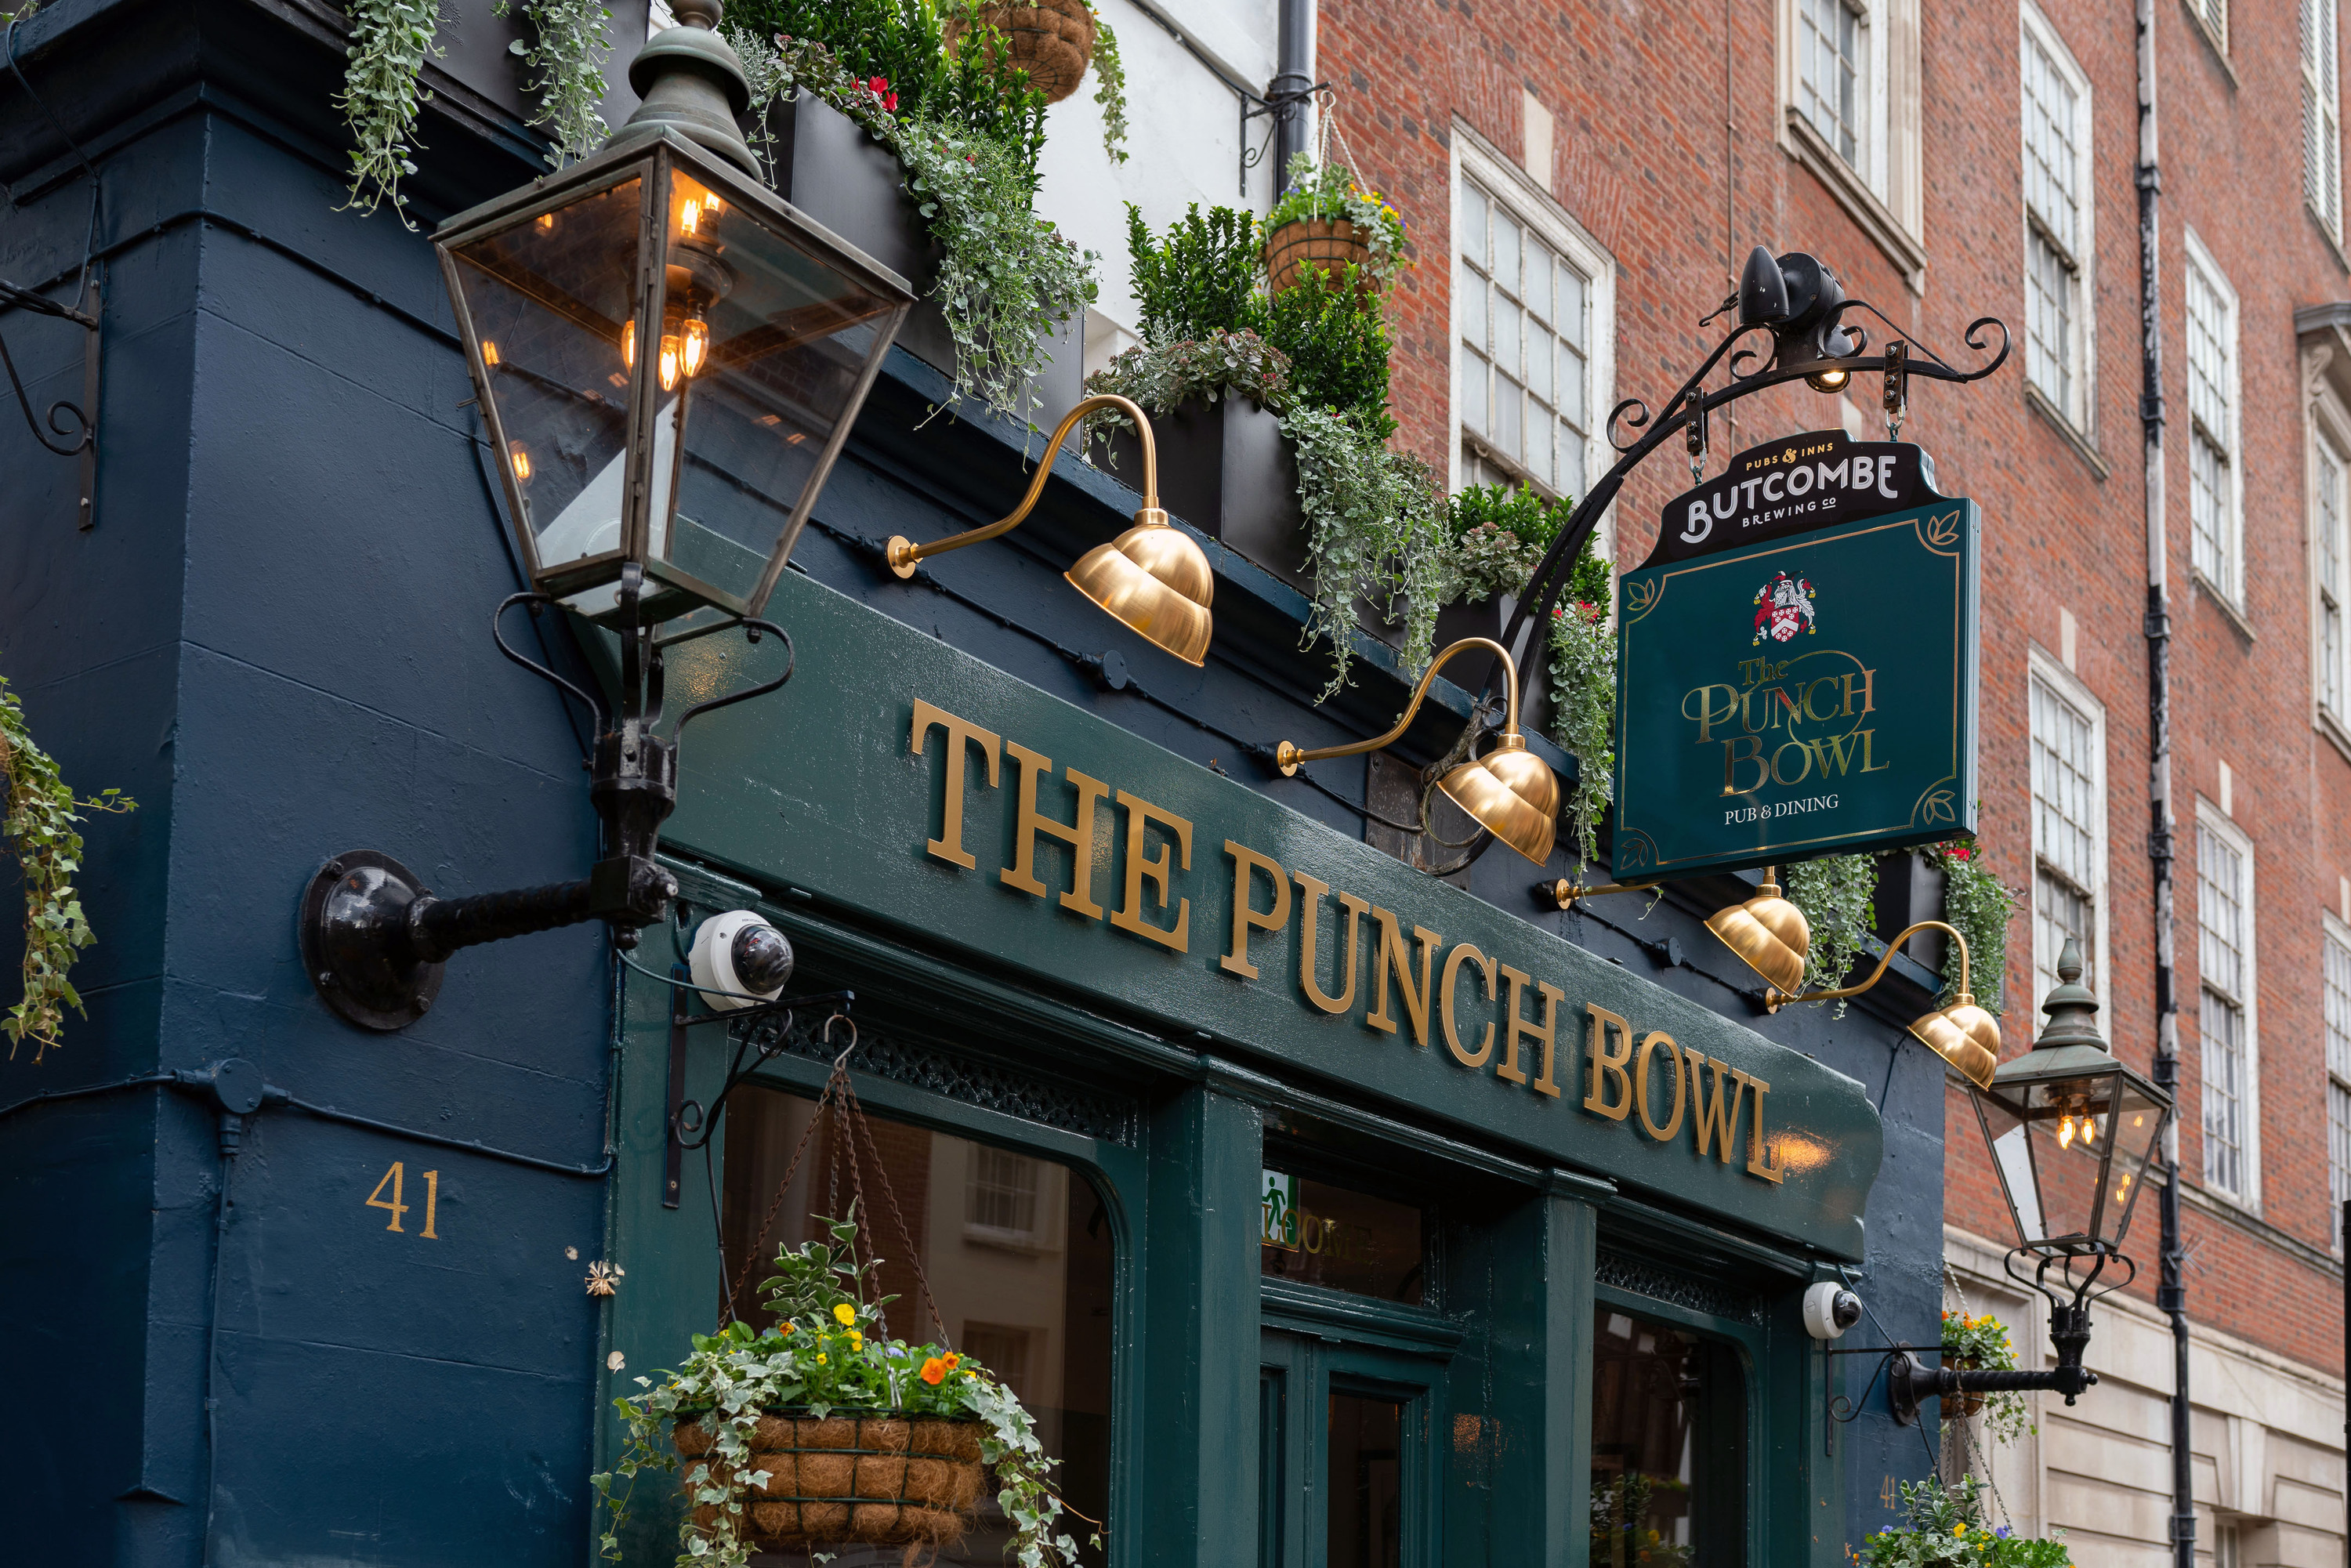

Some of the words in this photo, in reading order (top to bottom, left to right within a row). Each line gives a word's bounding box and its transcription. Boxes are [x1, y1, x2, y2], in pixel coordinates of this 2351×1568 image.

[1746, 454, 1778, 471] PUBS
[1782, 448, 1798, 464] &
[1801, 442, 1835, 458] INNS
[1679, 455, 1899, 544] BUTCOMBE
[1742, 501, 1817, 528] BREWING
[1738, 655, 1789, 686] The
[1682, 668, 1877, 744] PUNCH
[1719, 728, 1890, 797] BOWL
[1724, 806, 1757, 825] PUB
[1760, 805, 1772, 819] &
[1774, 794, 1839, 817] DINING
[911, 697, 1194, 954] THE
[1220, 838, 1566, 1099] PUNCH
[1583, 1001, 1784, 1186] BOWL
[365, 1161, 439, 1240] 41
[1880, 1474, 1896, 1510] 41
